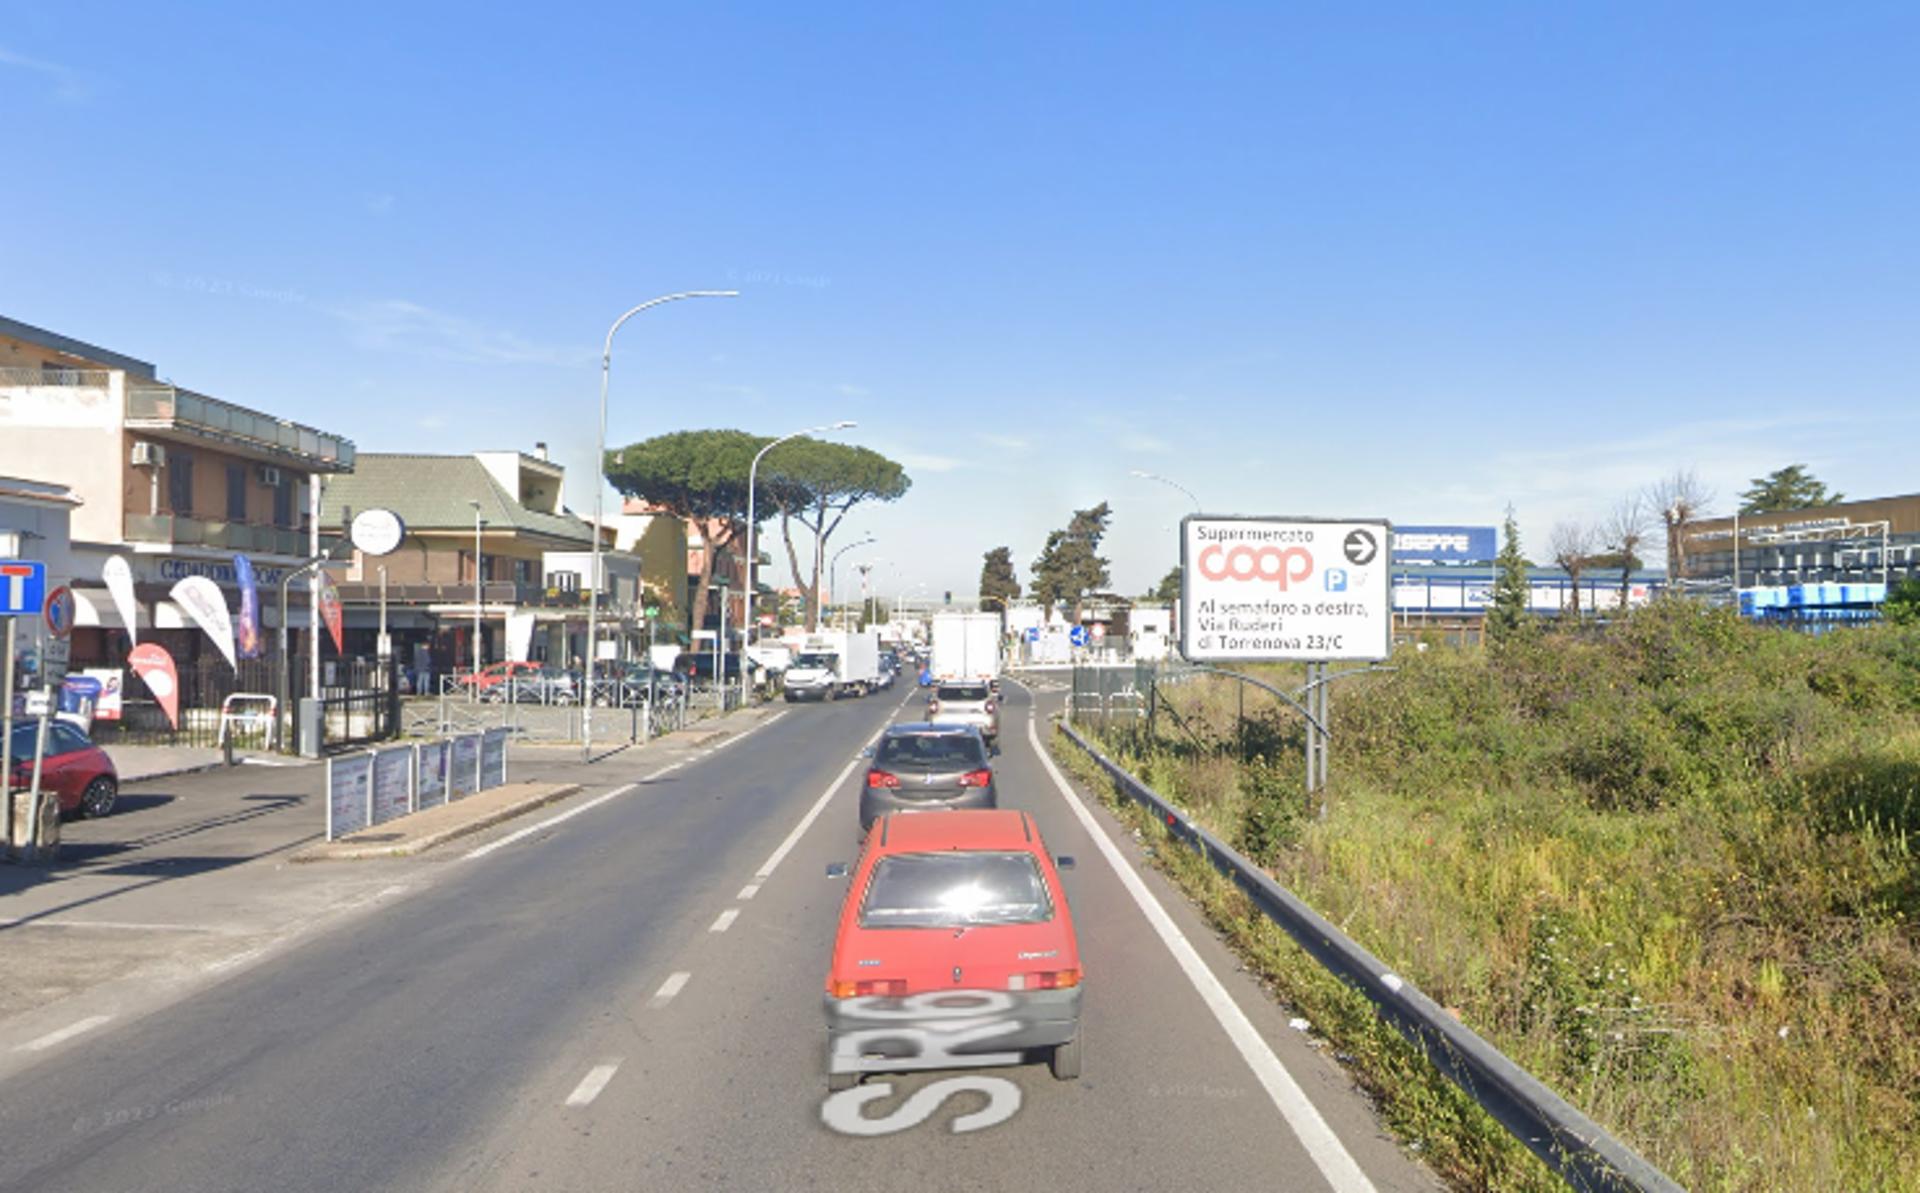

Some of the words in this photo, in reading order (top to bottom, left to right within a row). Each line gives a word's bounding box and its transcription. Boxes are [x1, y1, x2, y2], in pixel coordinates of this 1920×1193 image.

[1198, 526, 1314, 543] Supermercato
[1198, 544, 1314, 592] coop
[1199, 598, 1215, 614] Al
[1220, 599, 1298, 615] semaforo
[1301, 603, 1311, 615] a
[1315, 601, 1369, 618] destra,
[1199, 617, 1225, 631] Via
[1229, 617, 1283, 632] Ruderi
[1198, 635, 1211, 649] di
[1219, 635, 1301, 650] Torrenova
[1306, 635, 1343, 651] 23/C
